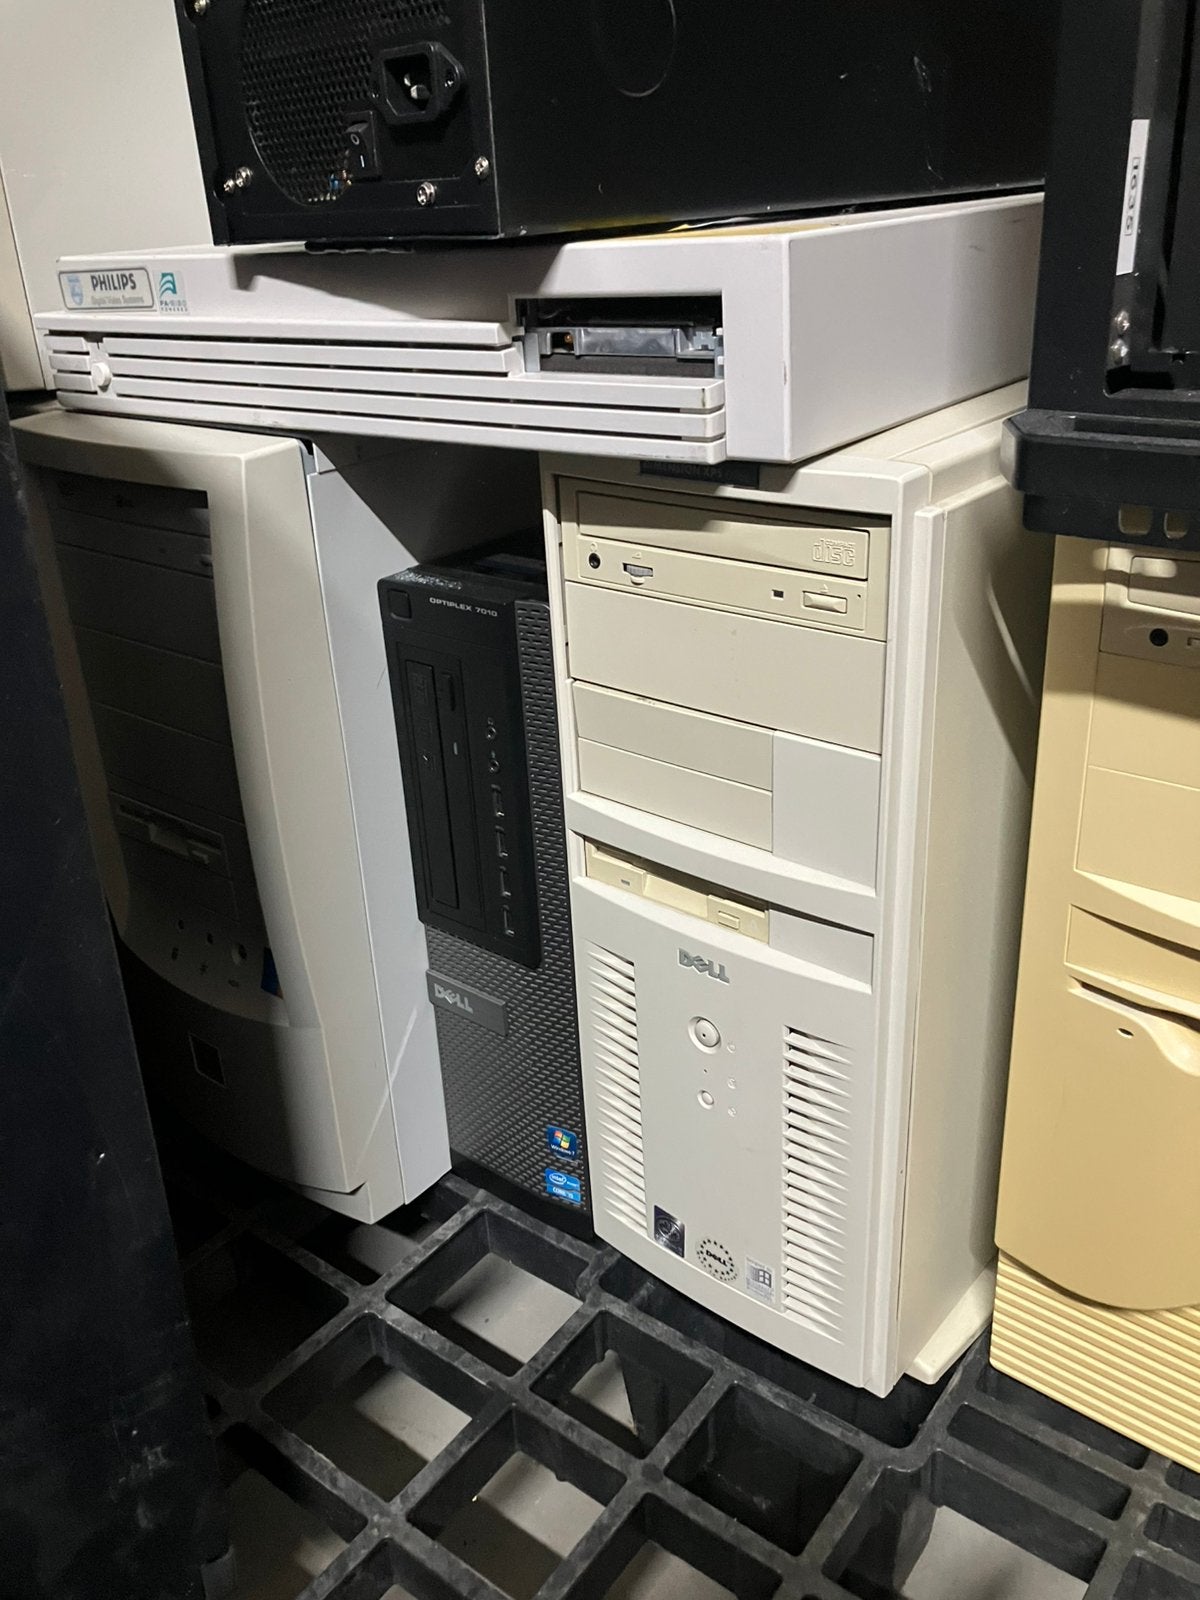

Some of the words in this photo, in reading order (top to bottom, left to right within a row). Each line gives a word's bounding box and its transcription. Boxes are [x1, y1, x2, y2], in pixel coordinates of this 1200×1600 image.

[90, 273, 137, 291] PHILIPS
[812, 538, 856, 567] disc
[429, 596, 472, 612] OPTIPLEX
[474, 606, 498, 617] 7010
[678, 947, 730, 985] DELL
[434, 983, 474, 1014] DELL
[551, 1143, 572, 1155] Windows
[706, 1249, 728, 1267] DELL
